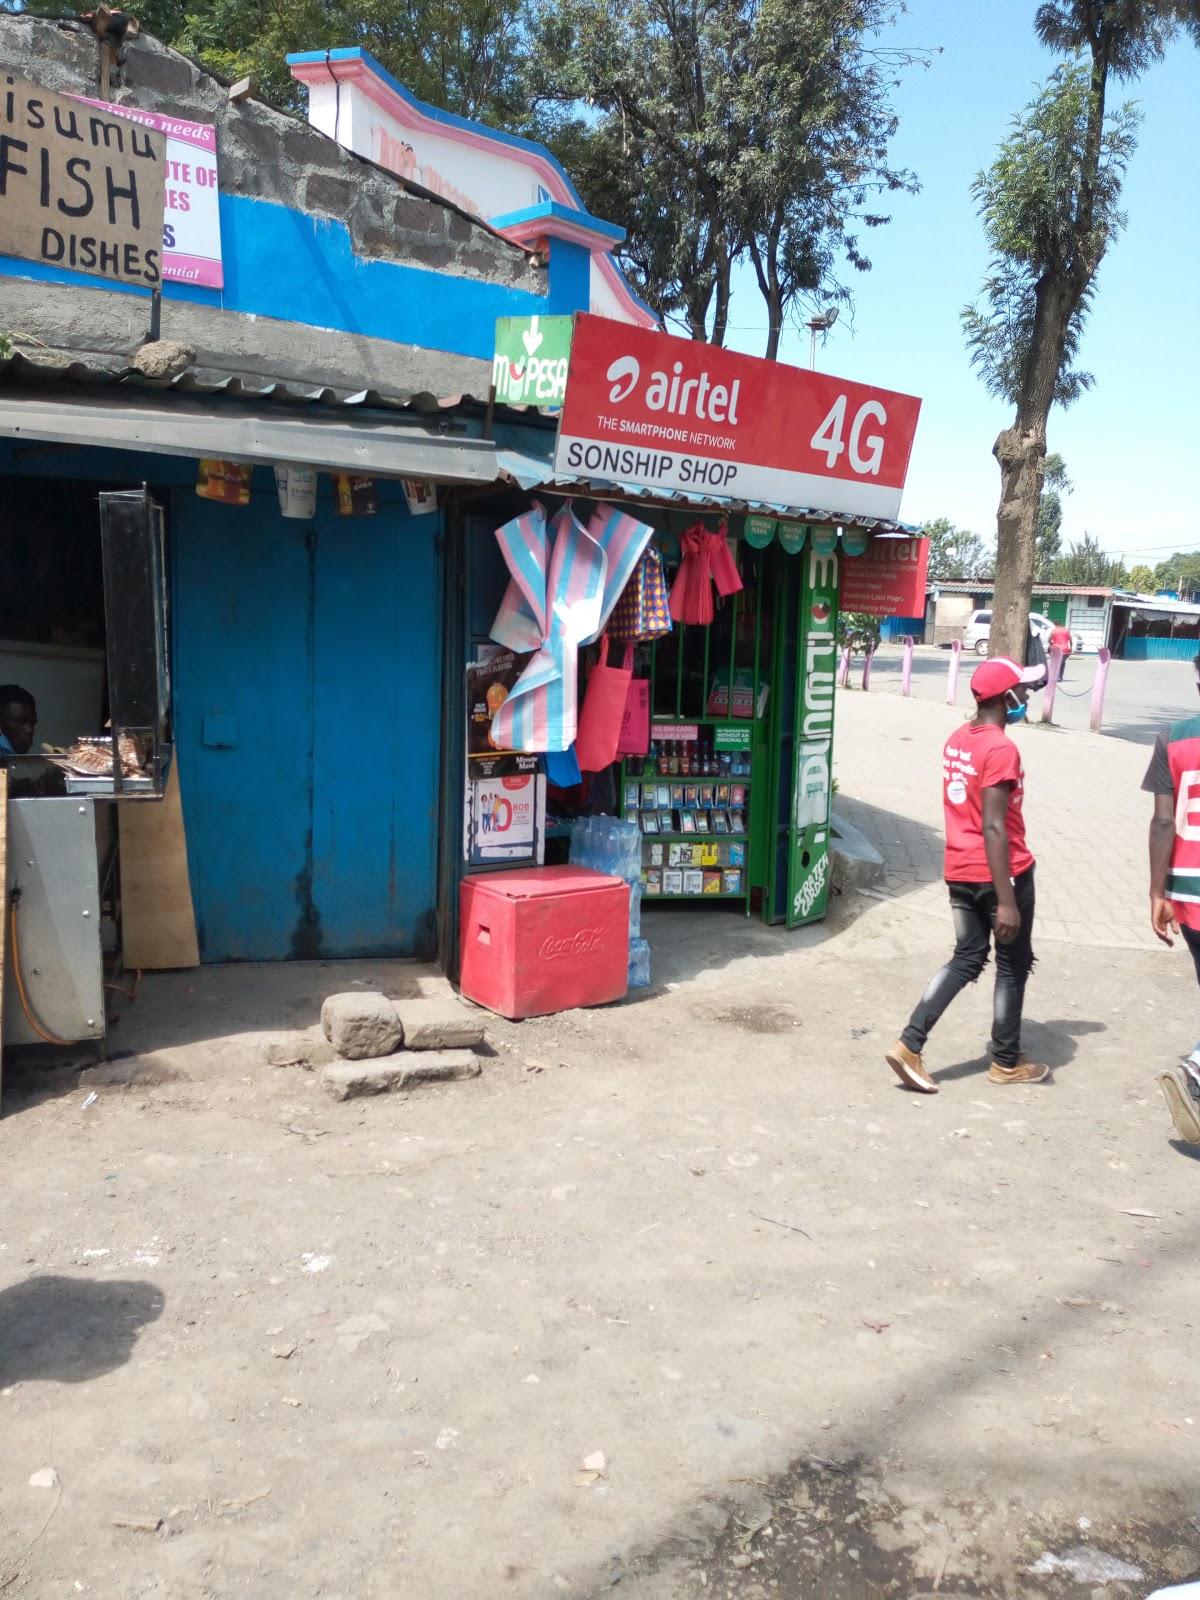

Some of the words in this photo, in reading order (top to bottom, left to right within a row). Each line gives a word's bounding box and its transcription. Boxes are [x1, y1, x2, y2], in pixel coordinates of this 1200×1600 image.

[161, 120, 211, 140] needs
[0, 134, 140, 229] FISH
[196, 166, 217, 188] OF
[41, 227, 160, 283] DISHES
[645, 361, 740, 425] airtel
[597, 415, 618, 430] THE
[619, 419, 688, 442] SMARTPHONE
[689, 431, 737, 450] NETWORK
[810, 394, 887, 476] 4G
[567, 442, 673, 478] SONSHIP
[679, 458, 737, 487] SHOP
[515, 756, 538, 764] Minute
